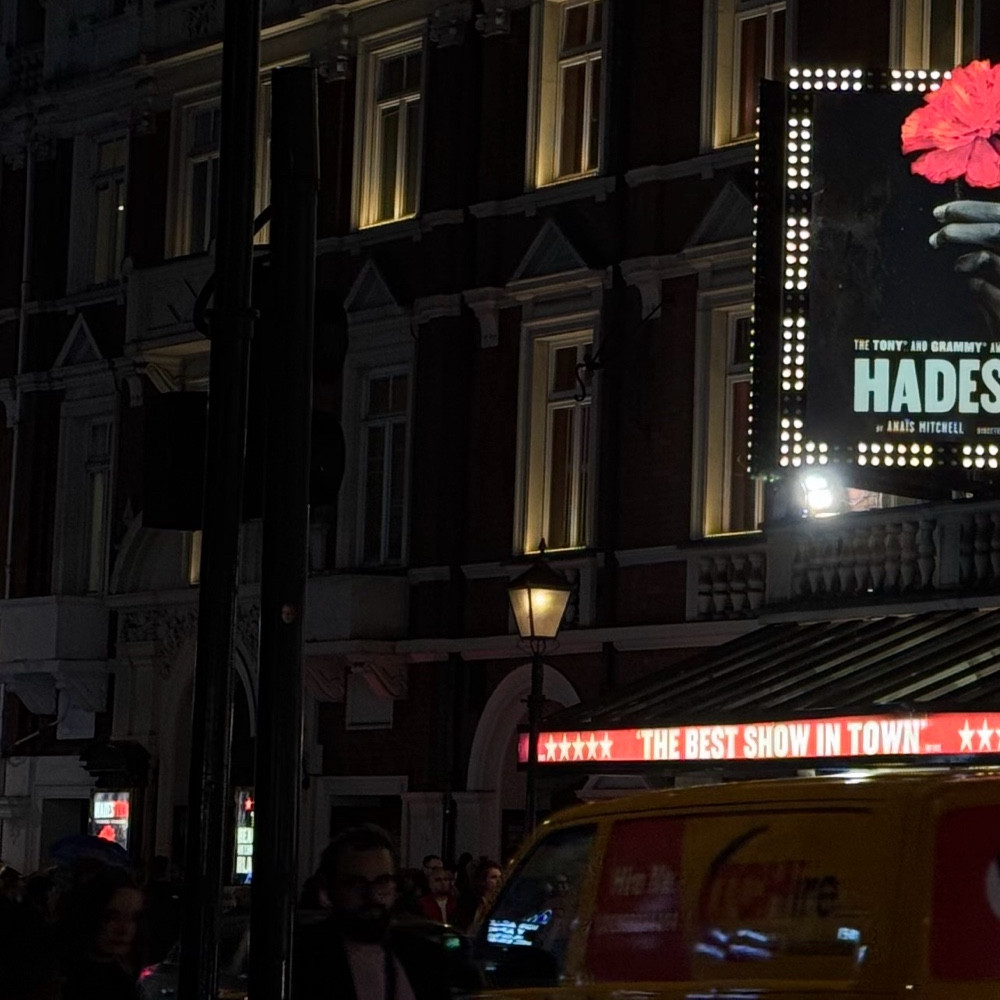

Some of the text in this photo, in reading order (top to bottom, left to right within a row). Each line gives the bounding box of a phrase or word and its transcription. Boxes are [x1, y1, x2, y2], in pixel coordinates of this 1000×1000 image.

[854, 339, 870, 351] THE
[910, 340, 928, 352] AND
[918, 420, 964, 435] MITCHELL
[685, 725, 738, 760] BEST
[743, 721, 810, 758] SHOW
[815, 722, 841, 757] IN
